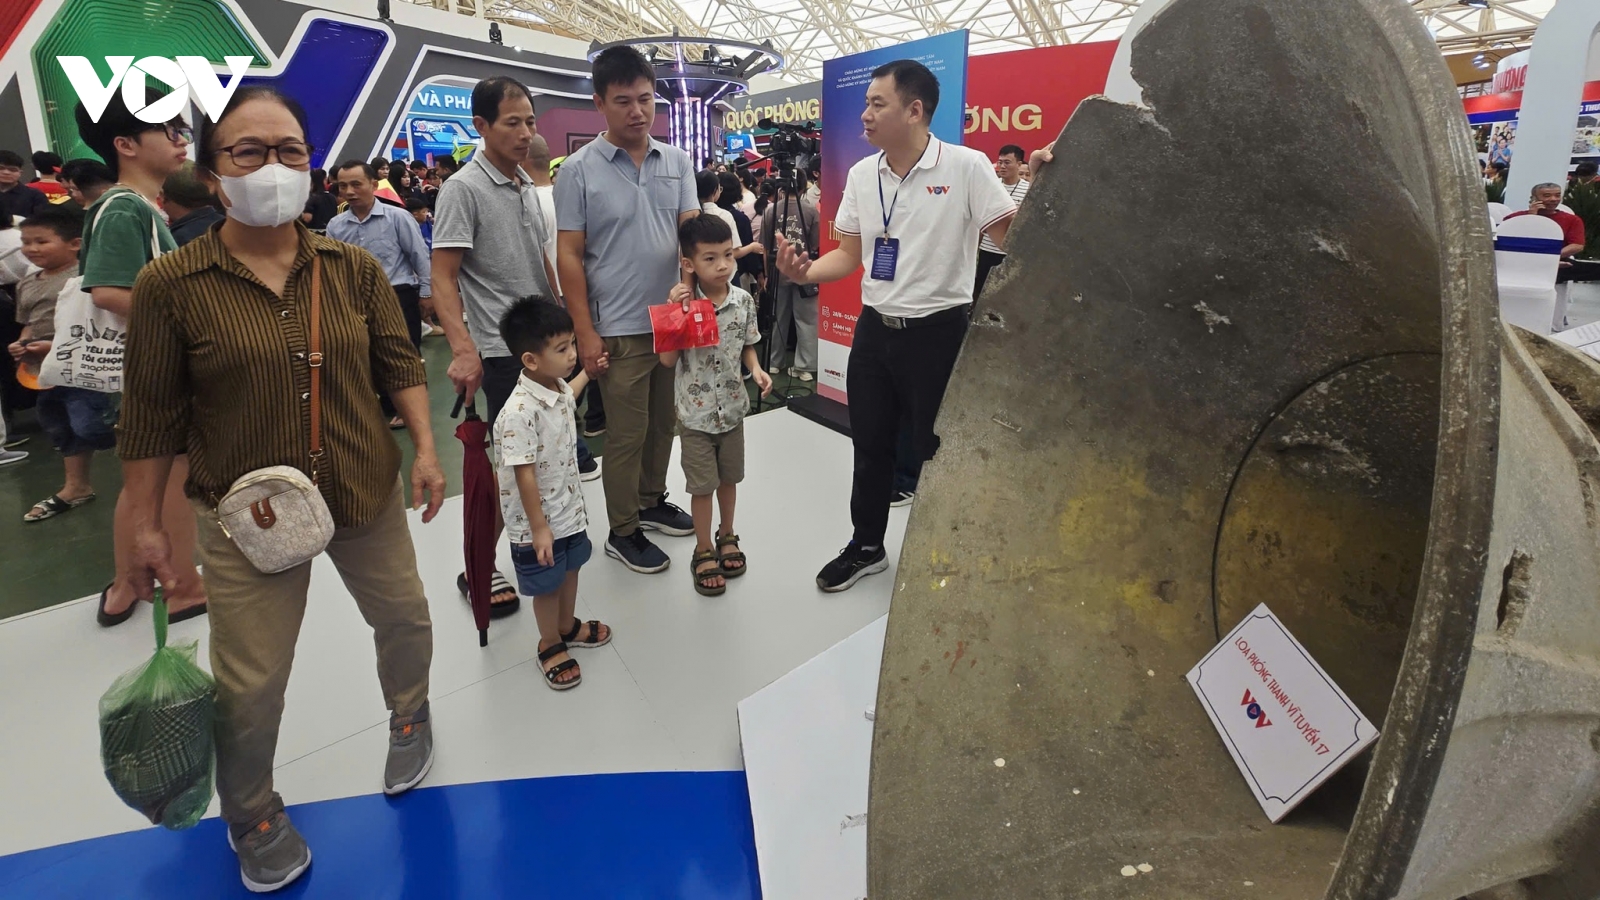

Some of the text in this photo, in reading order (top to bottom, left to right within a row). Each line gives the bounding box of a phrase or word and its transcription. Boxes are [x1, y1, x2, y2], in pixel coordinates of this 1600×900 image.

[417, 89, 441, 107] VÀ
[726, 96, 820, 131] QUỐC PHÒNG
[925, 185, 951, 195] VOV
[82, 354, 95, 363] TÔI
[86, 345, 103, 354] YÊU
[1235, 636, 1330, 756] LOA PHÓNG THANH VĨ TUYẾN 17
[1240, 688, 1273, 729] VOV
